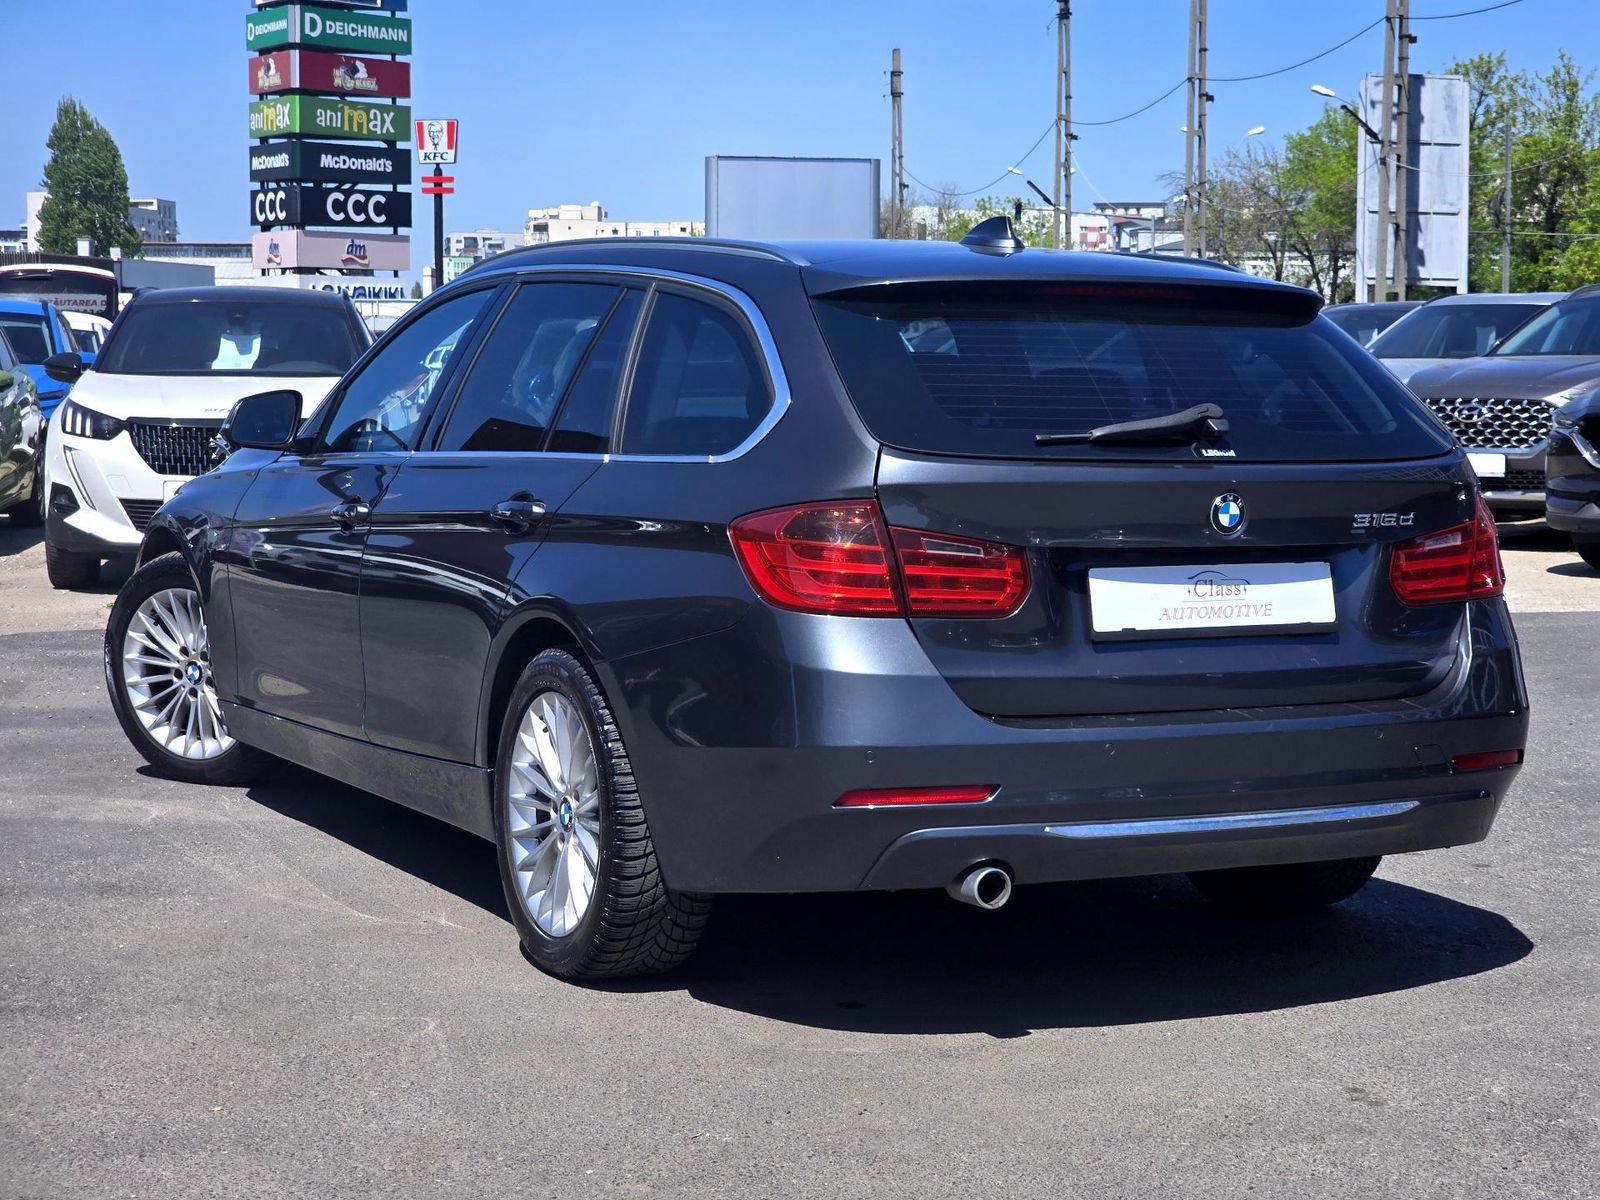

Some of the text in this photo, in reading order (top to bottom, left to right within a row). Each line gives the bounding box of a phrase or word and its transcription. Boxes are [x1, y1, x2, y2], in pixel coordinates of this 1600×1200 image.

[255, 18, 288, 35] DEICHMANN
[326, 20, 408, 42] DEICHMANN
[250, 102, 290, 132] animax
[316, 103, 395, 135] animax
[251, 152, 290, 171] McDonald's
[320, 153, 393, 173] McDonald's
[423, 151, 449, 161] KFC
[255, 190, 287, 222] CCC
[326, 191, 387, 224] CCC
[346, 239, 366, 256] dm
[1352, 512, 1416, 528] 316d
[1193, 579, 1242, 598] Class
[1159, 603, 1273, 622] AUTOMOTIVE
